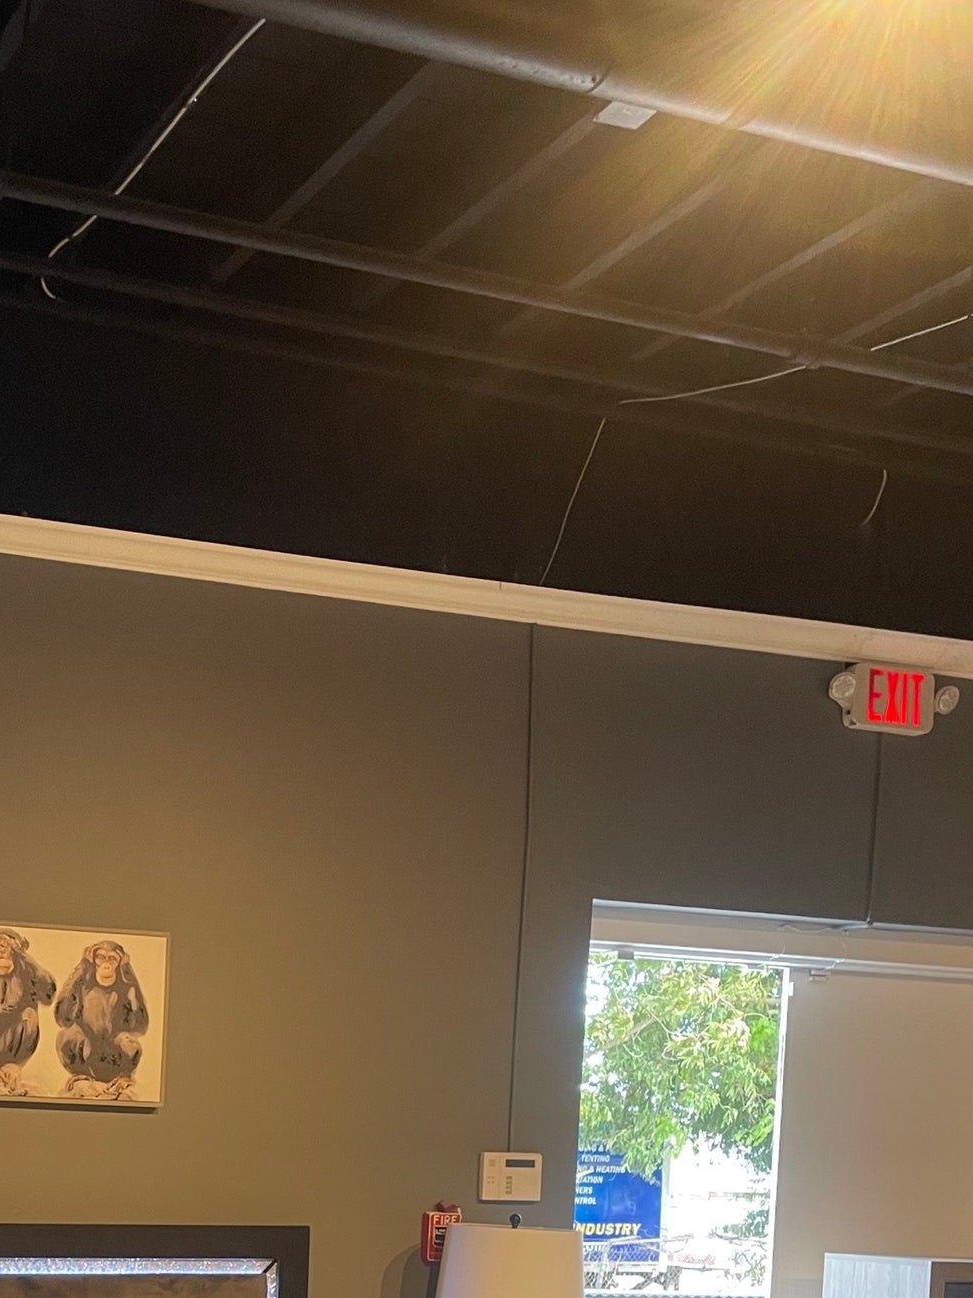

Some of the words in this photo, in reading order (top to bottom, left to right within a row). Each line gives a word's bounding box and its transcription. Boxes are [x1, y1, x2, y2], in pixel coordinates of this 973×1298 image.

[867, 667, 925, 728] EXIT
[574, 1196, 597, 1205] NTROL
[433, 1215, 458, 1225] FIRE
